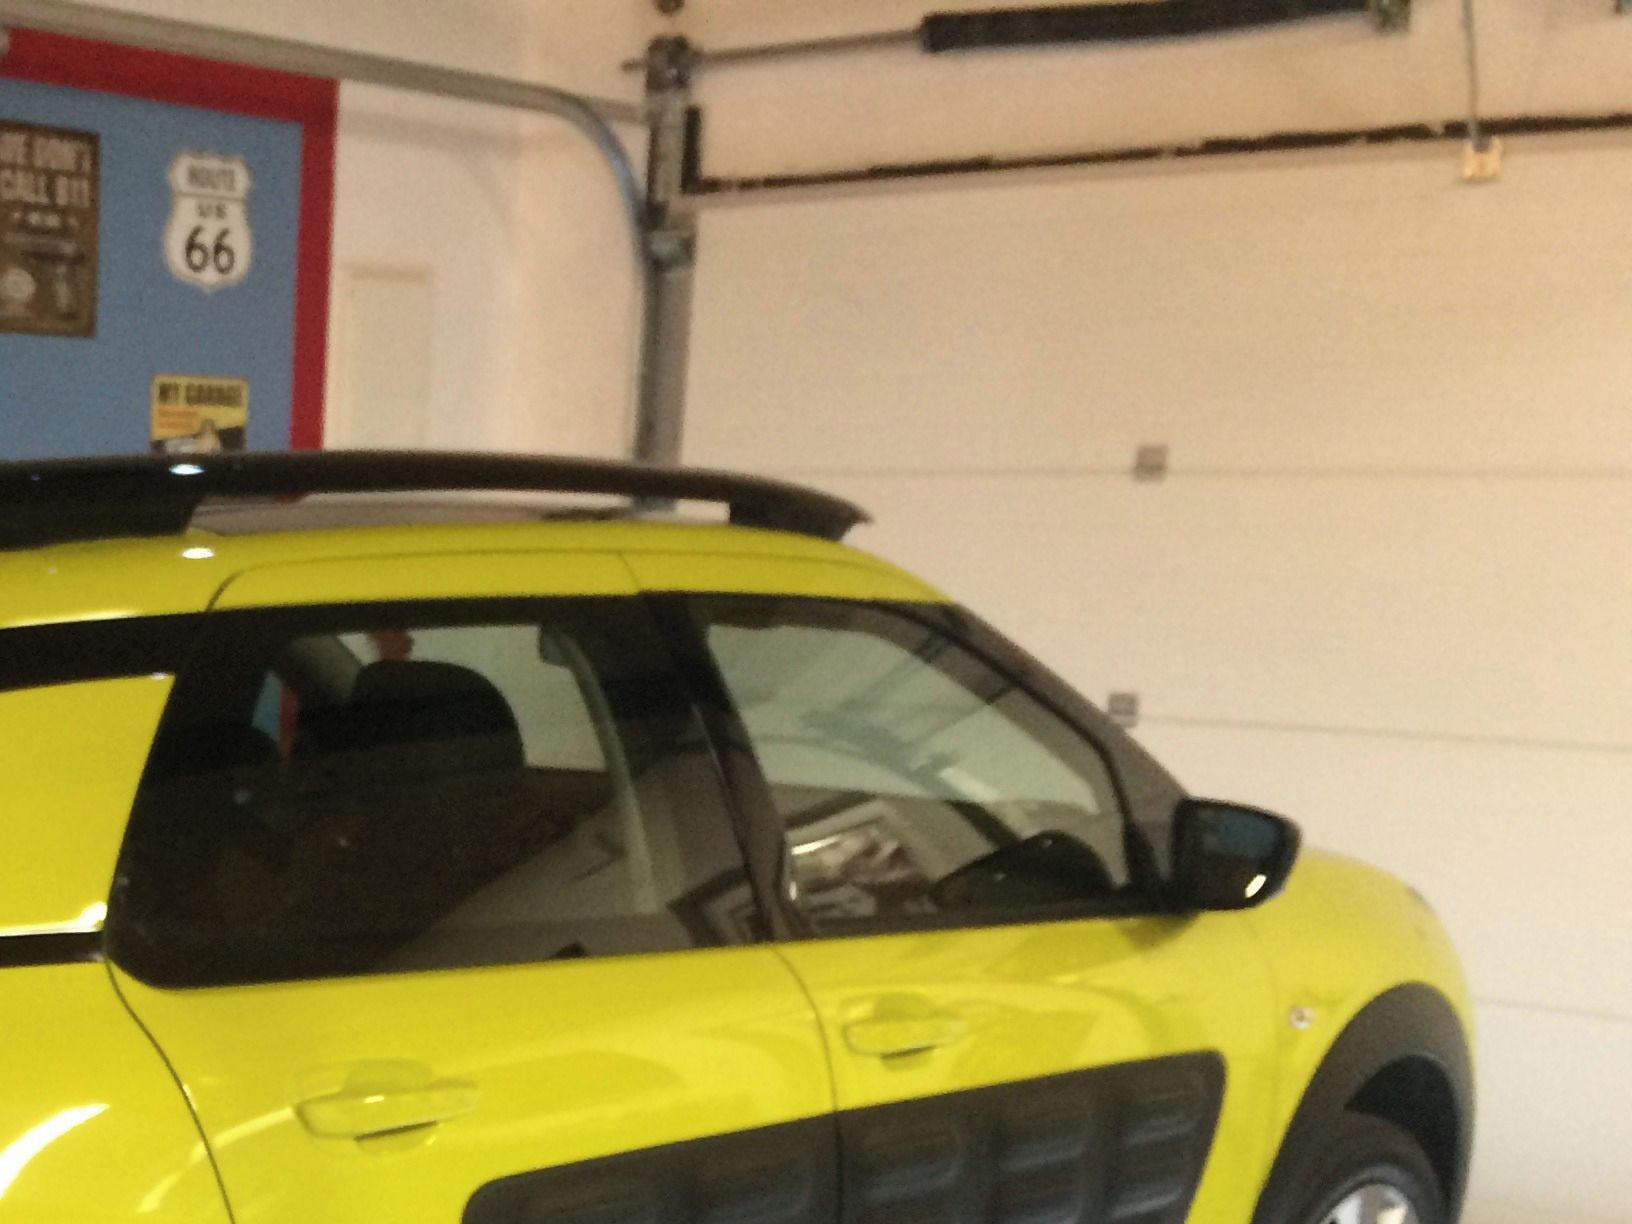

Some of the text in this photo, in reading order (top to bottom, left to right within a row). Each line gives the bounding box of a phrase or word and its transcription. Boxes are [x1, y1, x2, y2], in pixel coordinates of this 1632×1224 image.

[188, 165, 236, 192] ROUTE
[185, 225, 235, 274] 66
[185, 383, 243, 406] GARAGE
